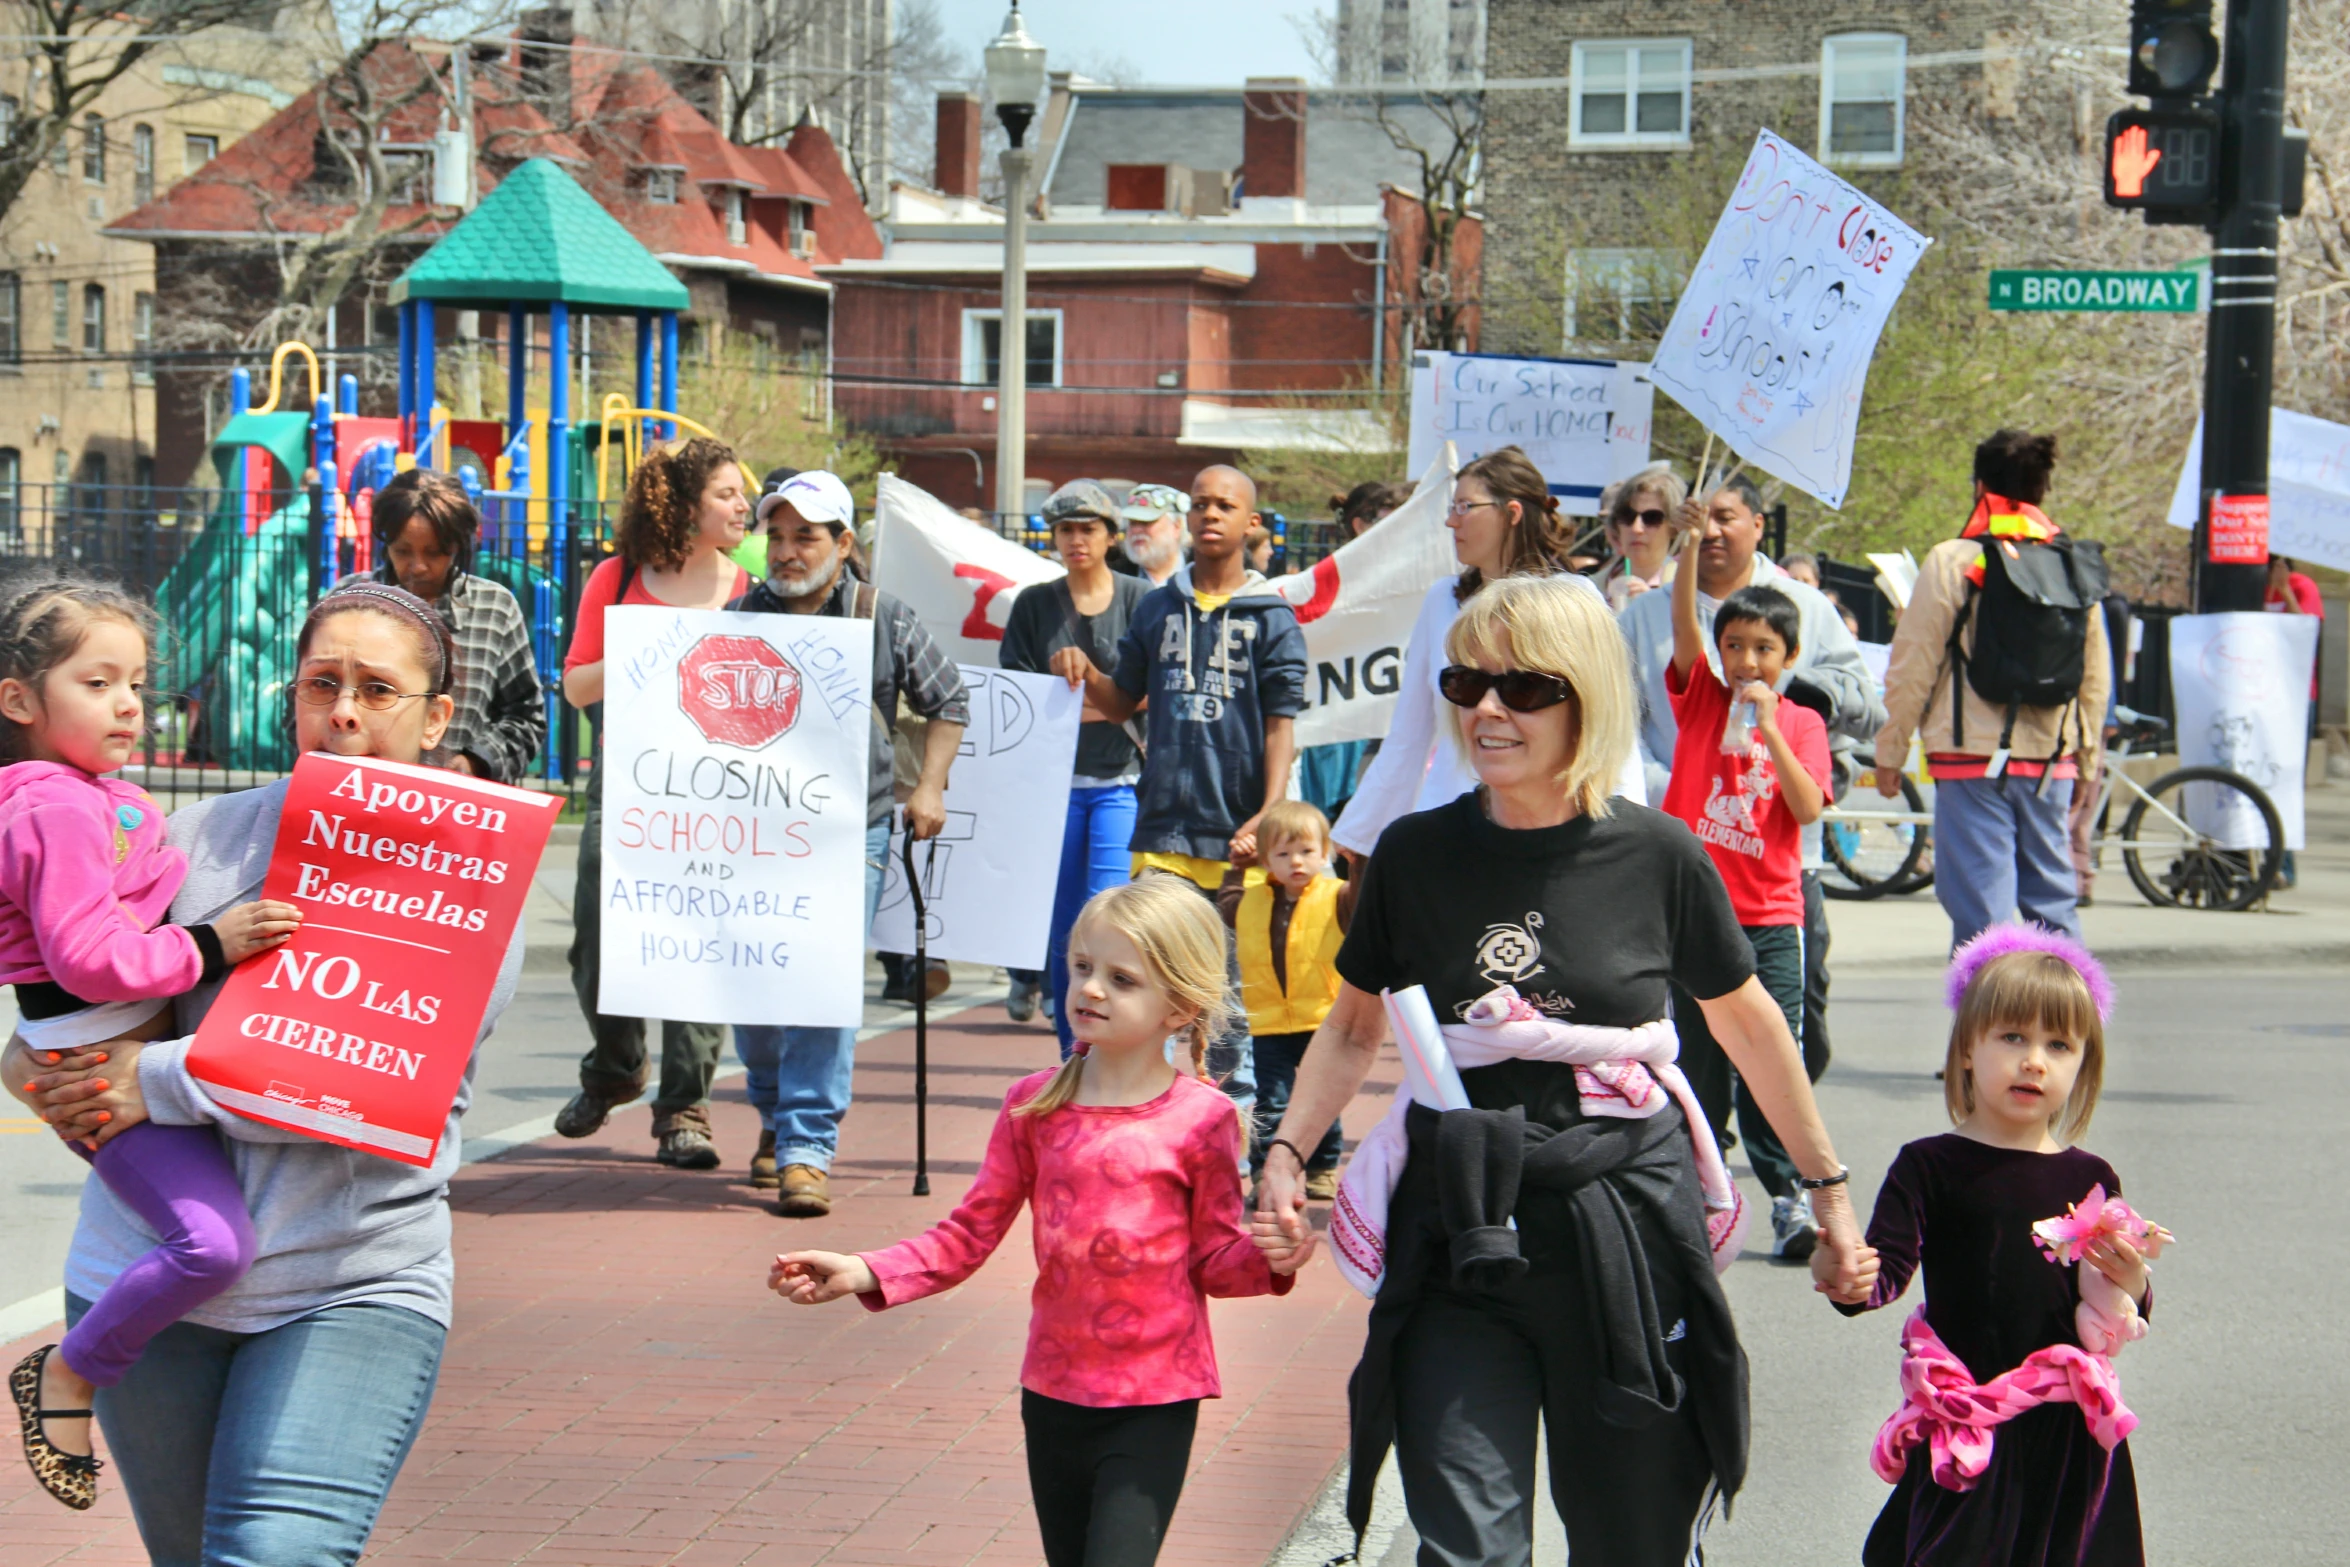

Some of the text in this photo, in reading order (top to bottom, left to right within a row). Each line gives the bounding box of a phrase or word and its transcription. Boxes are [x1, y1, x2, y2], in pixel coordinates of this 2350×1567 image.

[1838, 205, 1893, 274] Close
[2000, 277, 2191, 304] N BROADWAY
[1455, 360, 1499, 393] Our
[1488, 402, 1525, 434] Our
[624, 615, 694, 690] HONK
[793, 628, 872, 720] HONK
[699, 661, 799, 711] STOP
[329, 767, 508, 833] Apoyen
[633, 749, 832, 814] CLOSING
[301, 810, 509, 885] Nuestras
[618, 807, 812, 858] SCHOOLS
[1696, 817, 1764, 860] ELEMENTARY
[684, 859, 734, 880] AND
[290, 862, 490, 932] Escuelas
[609, 878, 811, 920] AFFORDABLE
[641, 931, 790, 969] HOUSING
[261, 949, 442, 1025] NO LAS
[239, 1012, 427, 1081] CIERREN
[318, 1103, 365, 1121] CHICAGO
